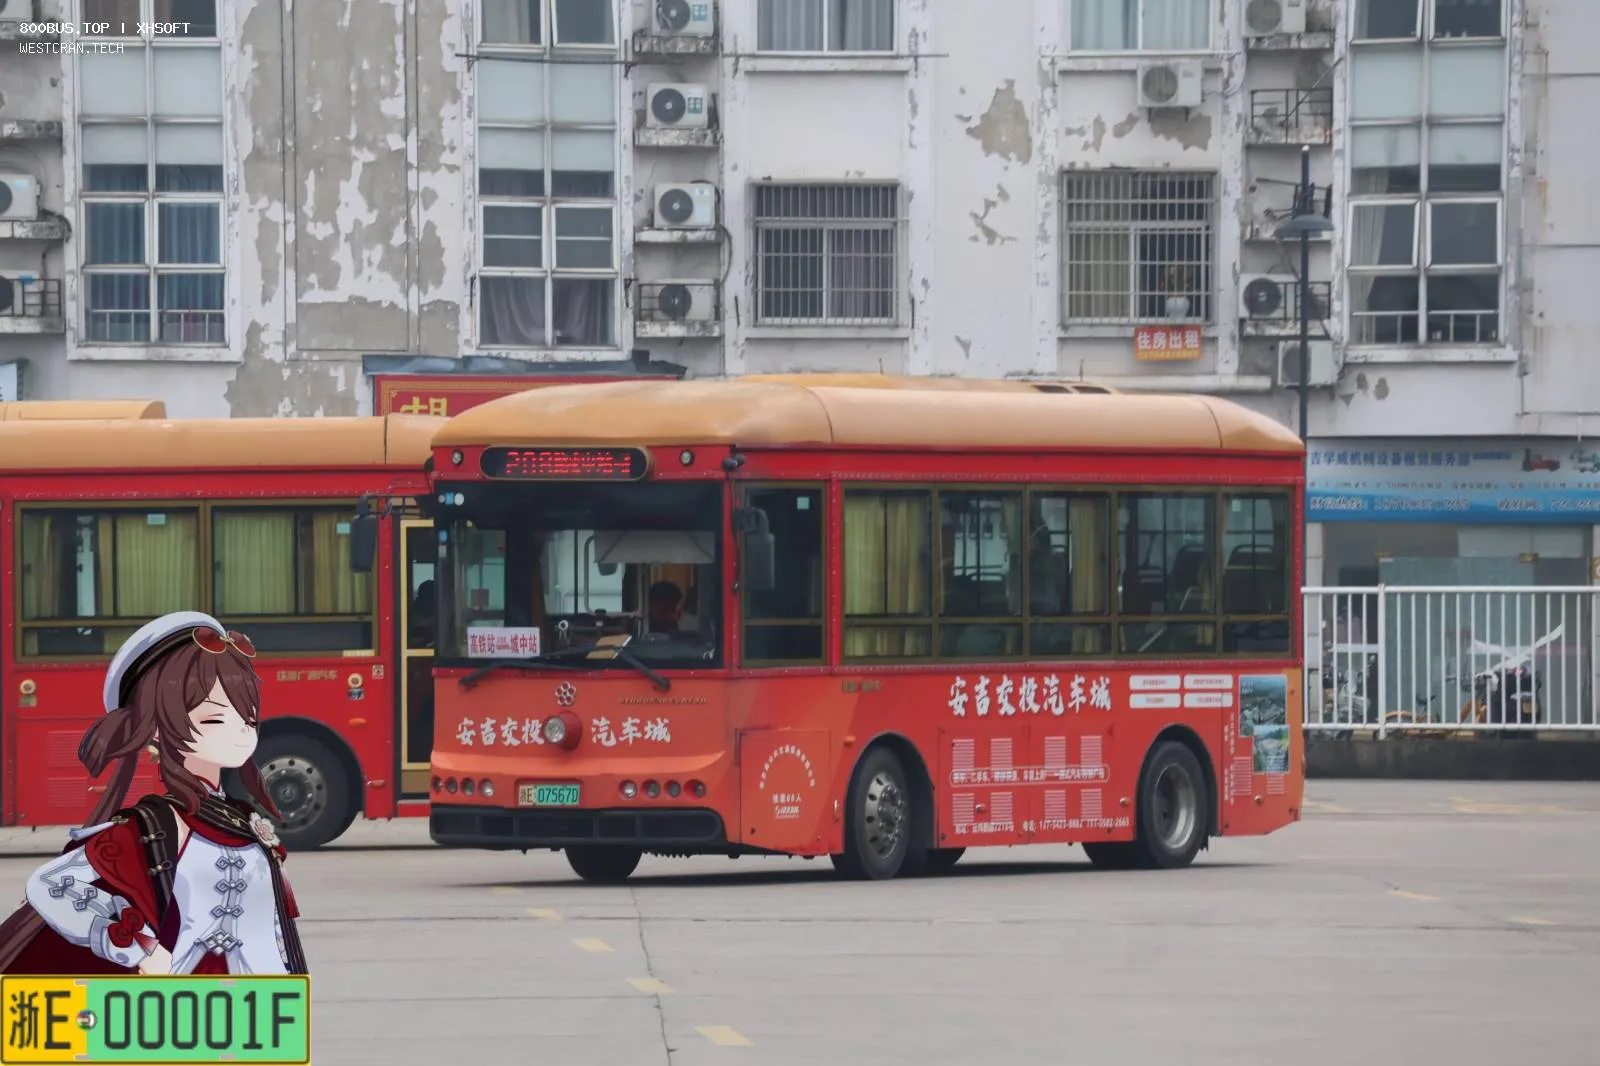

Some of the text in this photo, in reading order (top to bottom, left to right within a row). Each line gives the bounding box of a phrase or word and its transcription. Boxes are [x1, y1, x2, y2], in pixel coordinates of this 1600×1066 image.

[1137, 330, 1200, 350] 住房出租
[470, 632, 496, 654] 高铁站
[511, 632, 537, 655] 城中站
[948, 673, 1112, 716] 安吉交投汽车城
[456, 716, 671, 747] 安吉交投 汽车城
[538, 787, 578, 803] 07567D
